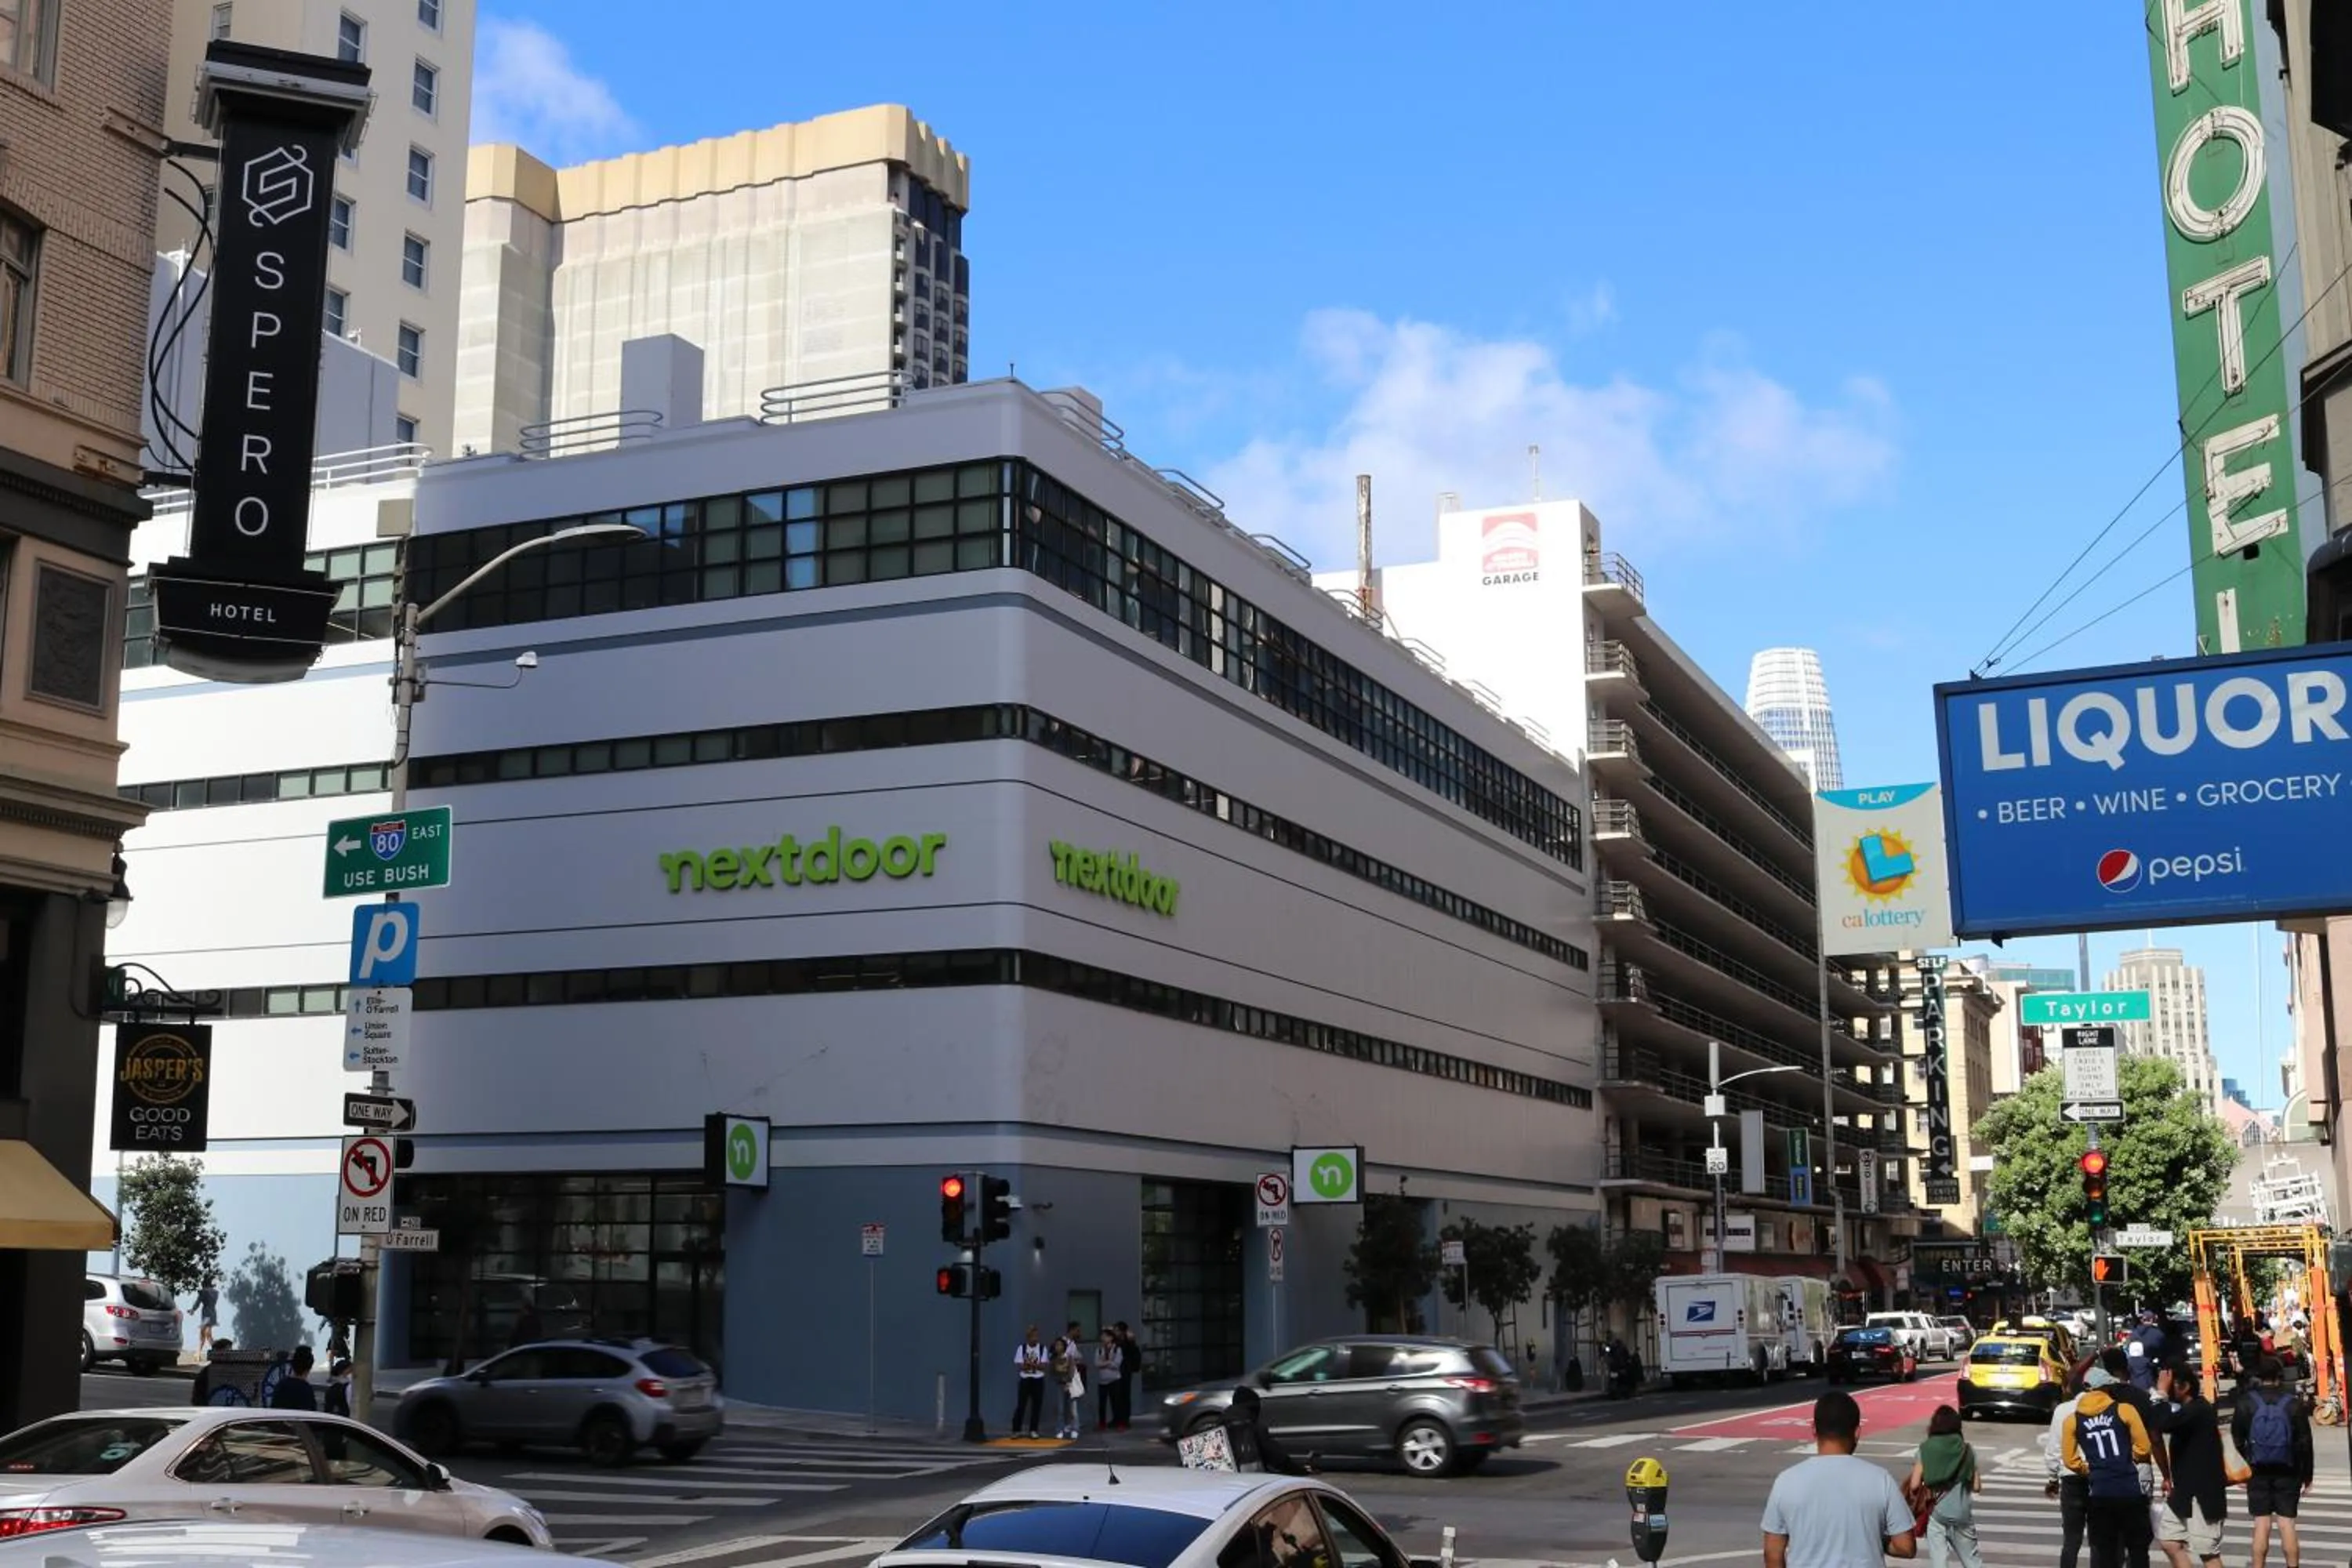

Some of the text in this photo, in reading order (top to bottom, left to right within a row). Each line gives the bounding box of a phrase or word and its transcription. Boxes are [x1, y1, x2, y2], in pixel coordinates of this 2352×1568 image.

[234, 251, 285, 536] SPERO
[1482, 572, 1540, 586] GARAGE
[209, 601, 277, 624] HOTEL
[1978, 670, 2350, 771] LIQUOR
[1858, 790, 1896, 805] PLAY
[1998, 772, 2342, 824] BEER WINE GROCERY
[412, 825, 442, 840] EAST
[376, 833, 399, 853] 80
[659, 826, 946, 892] nextdoor
[2148, 848, 2242, 885] pepsi
[343, 864, 430, 887] USE BUSH
[1049, 839, 1179, 916] nextdoor
[1917, 957, 1947, 970] SELF
[2045, 1000, 2127, 1018] Taylor
[120, 1056, 204, 1082] JASPER'S
[1923, 974, 1951, 1156] PARKING
[129, 1106, 191, 1123] GOOD
[350, 1103, 393, 1120] ONE WAY
[136, 1125, 183, 1141] EATS
[1709, 1161, 1726, 1172] 20
[343, 1207, 387, 1222] ON RED
[2119, 1234, 2161, 1245] Taylor
[1941, 1259, 1992, 1272] ENTER
[2086, 1428, 2120, 1459] 77
